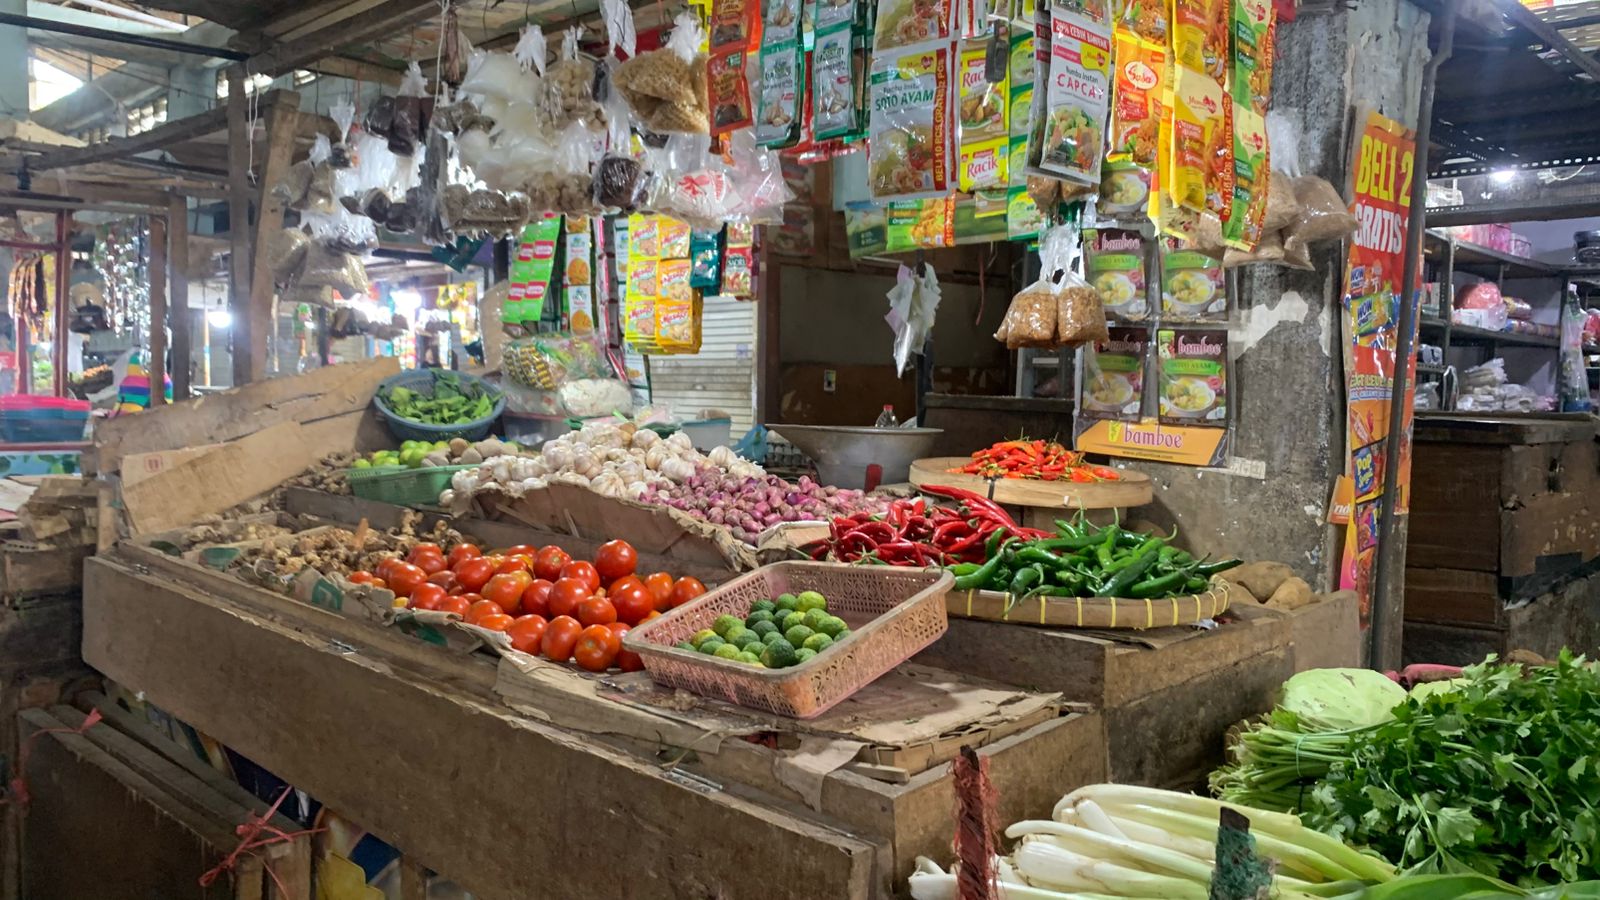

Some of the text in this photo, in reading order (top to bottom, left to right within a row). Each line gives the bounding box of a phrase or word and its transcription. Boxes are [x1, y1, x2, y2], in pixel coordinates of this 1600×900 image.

[962, 70, 985, 88] Rac
[1057, 73, 1104, 100] CAPCAY
[875, 95, 898, 112] SOTO
[901, 90, 934, 106] AYAM
[935, 146, 944, 157] 10
[934, 159, 944, 182] BELI
[966, 157, 998, 178] Racik
[1357, 135, 1414, 206] BELI 2
[1353, 203, 1403, 255] GRATIS
[1102, 232, 1141, 251] bamboe
[1177, 335, 1221, 355] bamboe
[1124, 423, 1183, 448] bamboe
